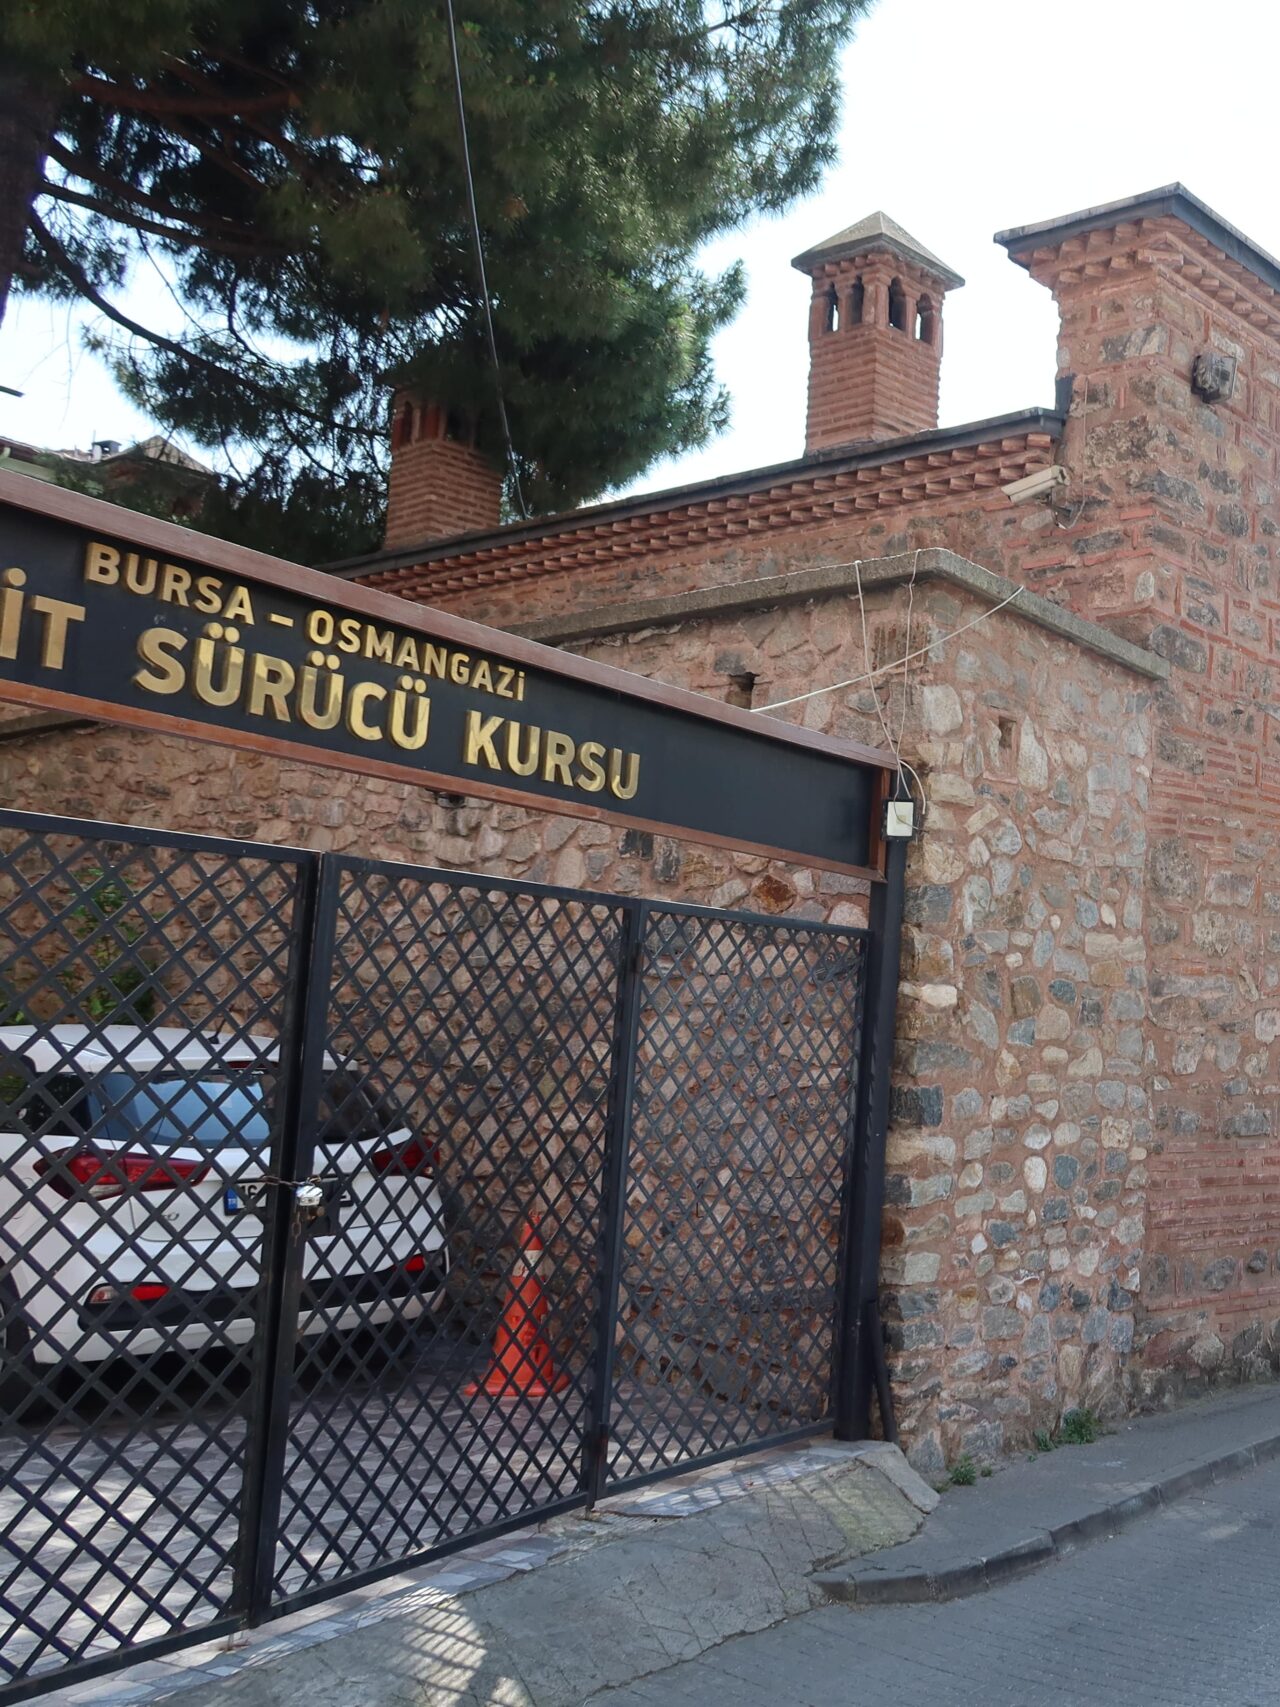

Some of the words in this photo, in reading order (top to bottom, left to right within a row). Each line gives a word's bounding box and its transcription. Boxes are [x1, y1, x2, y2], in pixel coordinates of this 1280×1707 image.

[84, 542, 256, 626] BURSA
[132, 621, 431, 750] SÜRÜCÜ
[463, 709, 641, 800] KURSU
